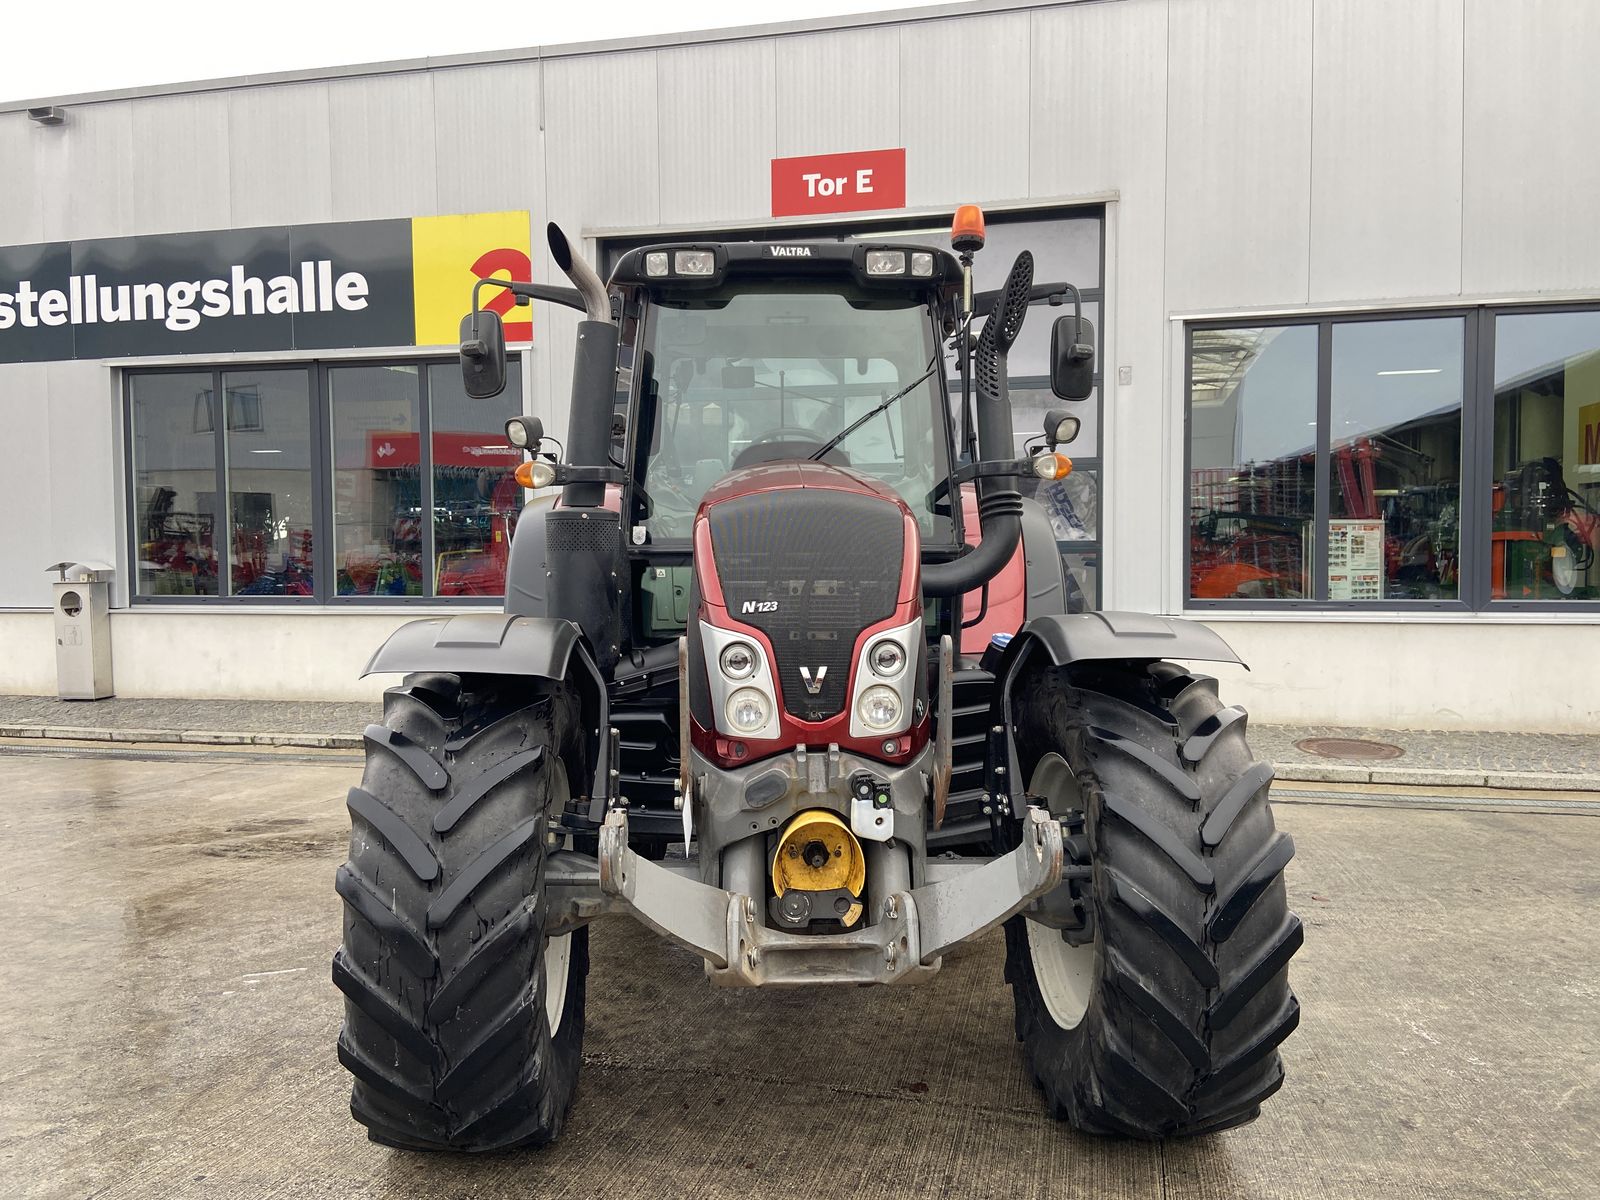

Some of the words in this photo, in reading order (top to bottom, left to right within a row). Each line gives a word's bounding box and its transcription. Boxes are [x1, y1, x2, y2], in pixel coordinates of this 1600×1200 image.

[802, 173, 847, 197] Tor
[856, 169, 874, 193] E
[770, 246, 812, 257] VALTRA
[0, 259, 369, 332] stellungshalle
